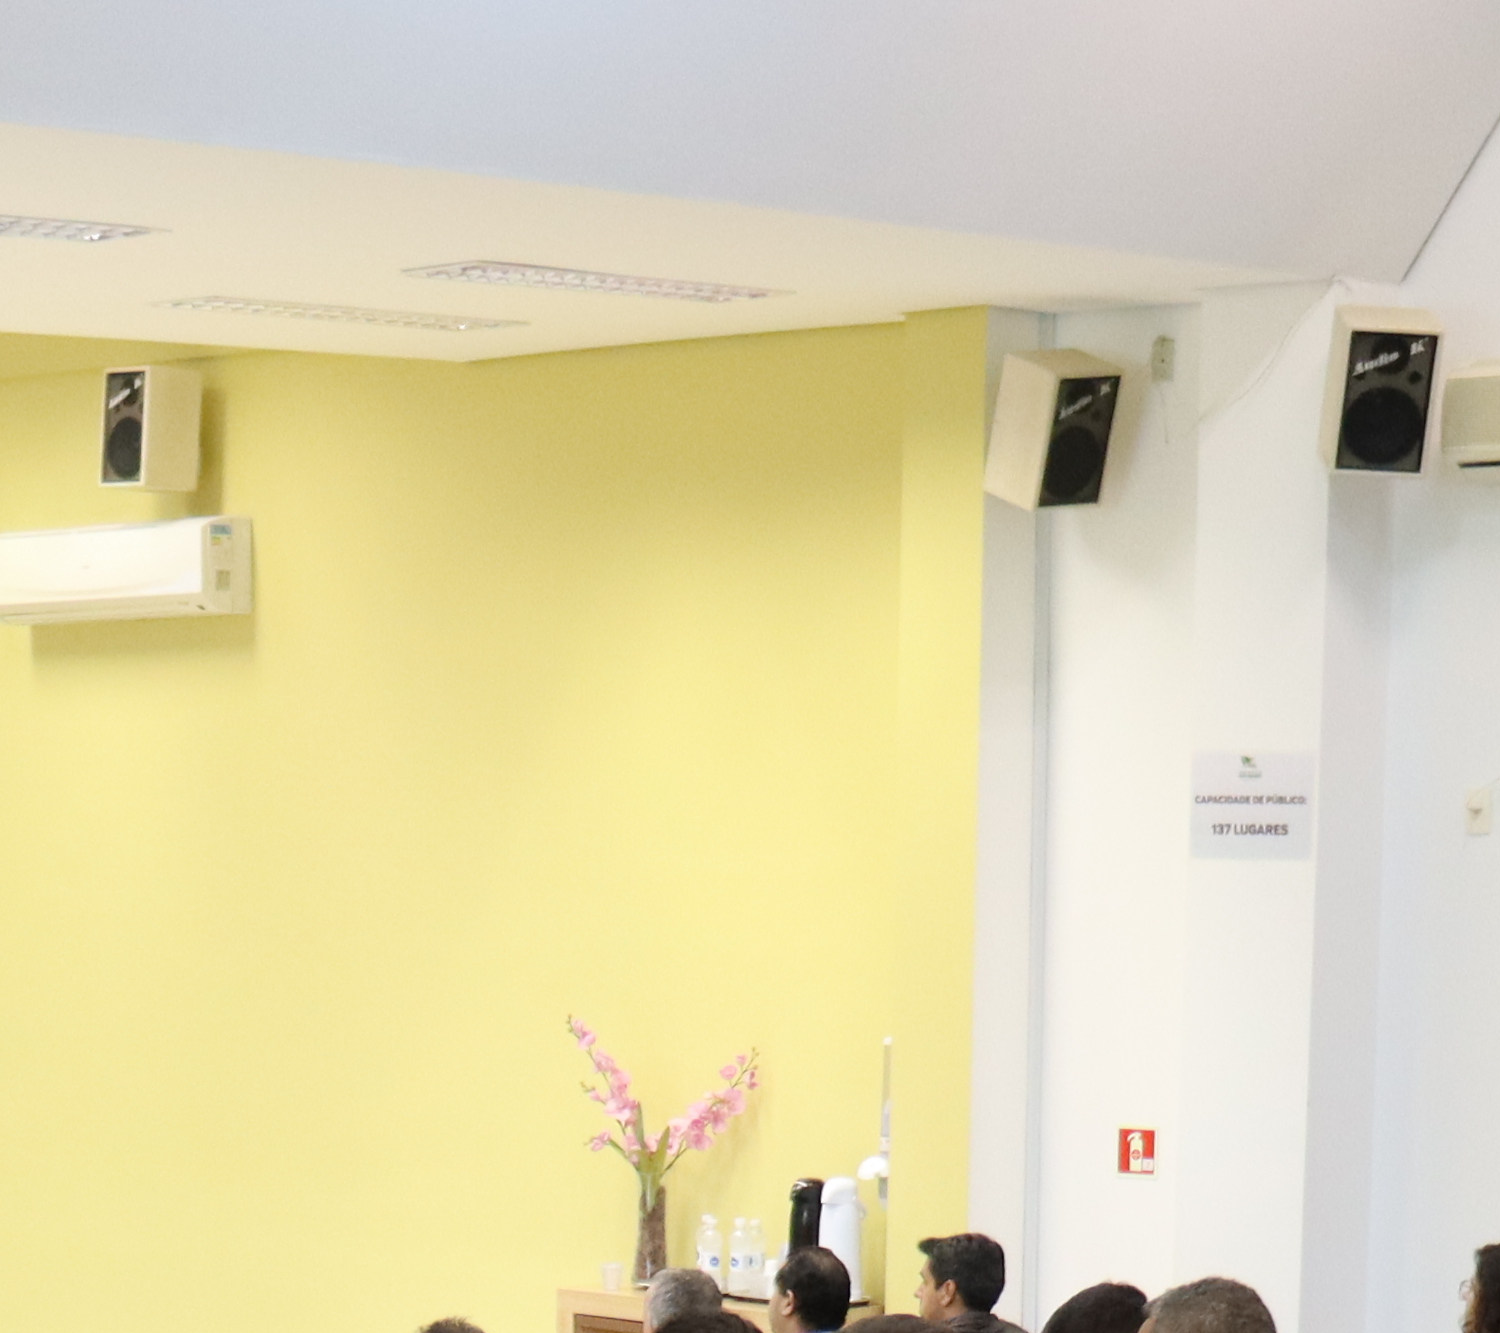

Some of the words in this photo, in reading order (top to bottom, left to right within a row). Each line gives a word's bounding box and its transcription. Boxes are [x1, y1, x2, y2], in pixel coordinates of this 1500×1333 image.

[1194, 795, 1250, 804] CAPACIDADE
[1251, 795, 1264, 804] DE
[1211, 823, 1231, 835] 137
[1234, 823, 1288, 835] LUGARES
